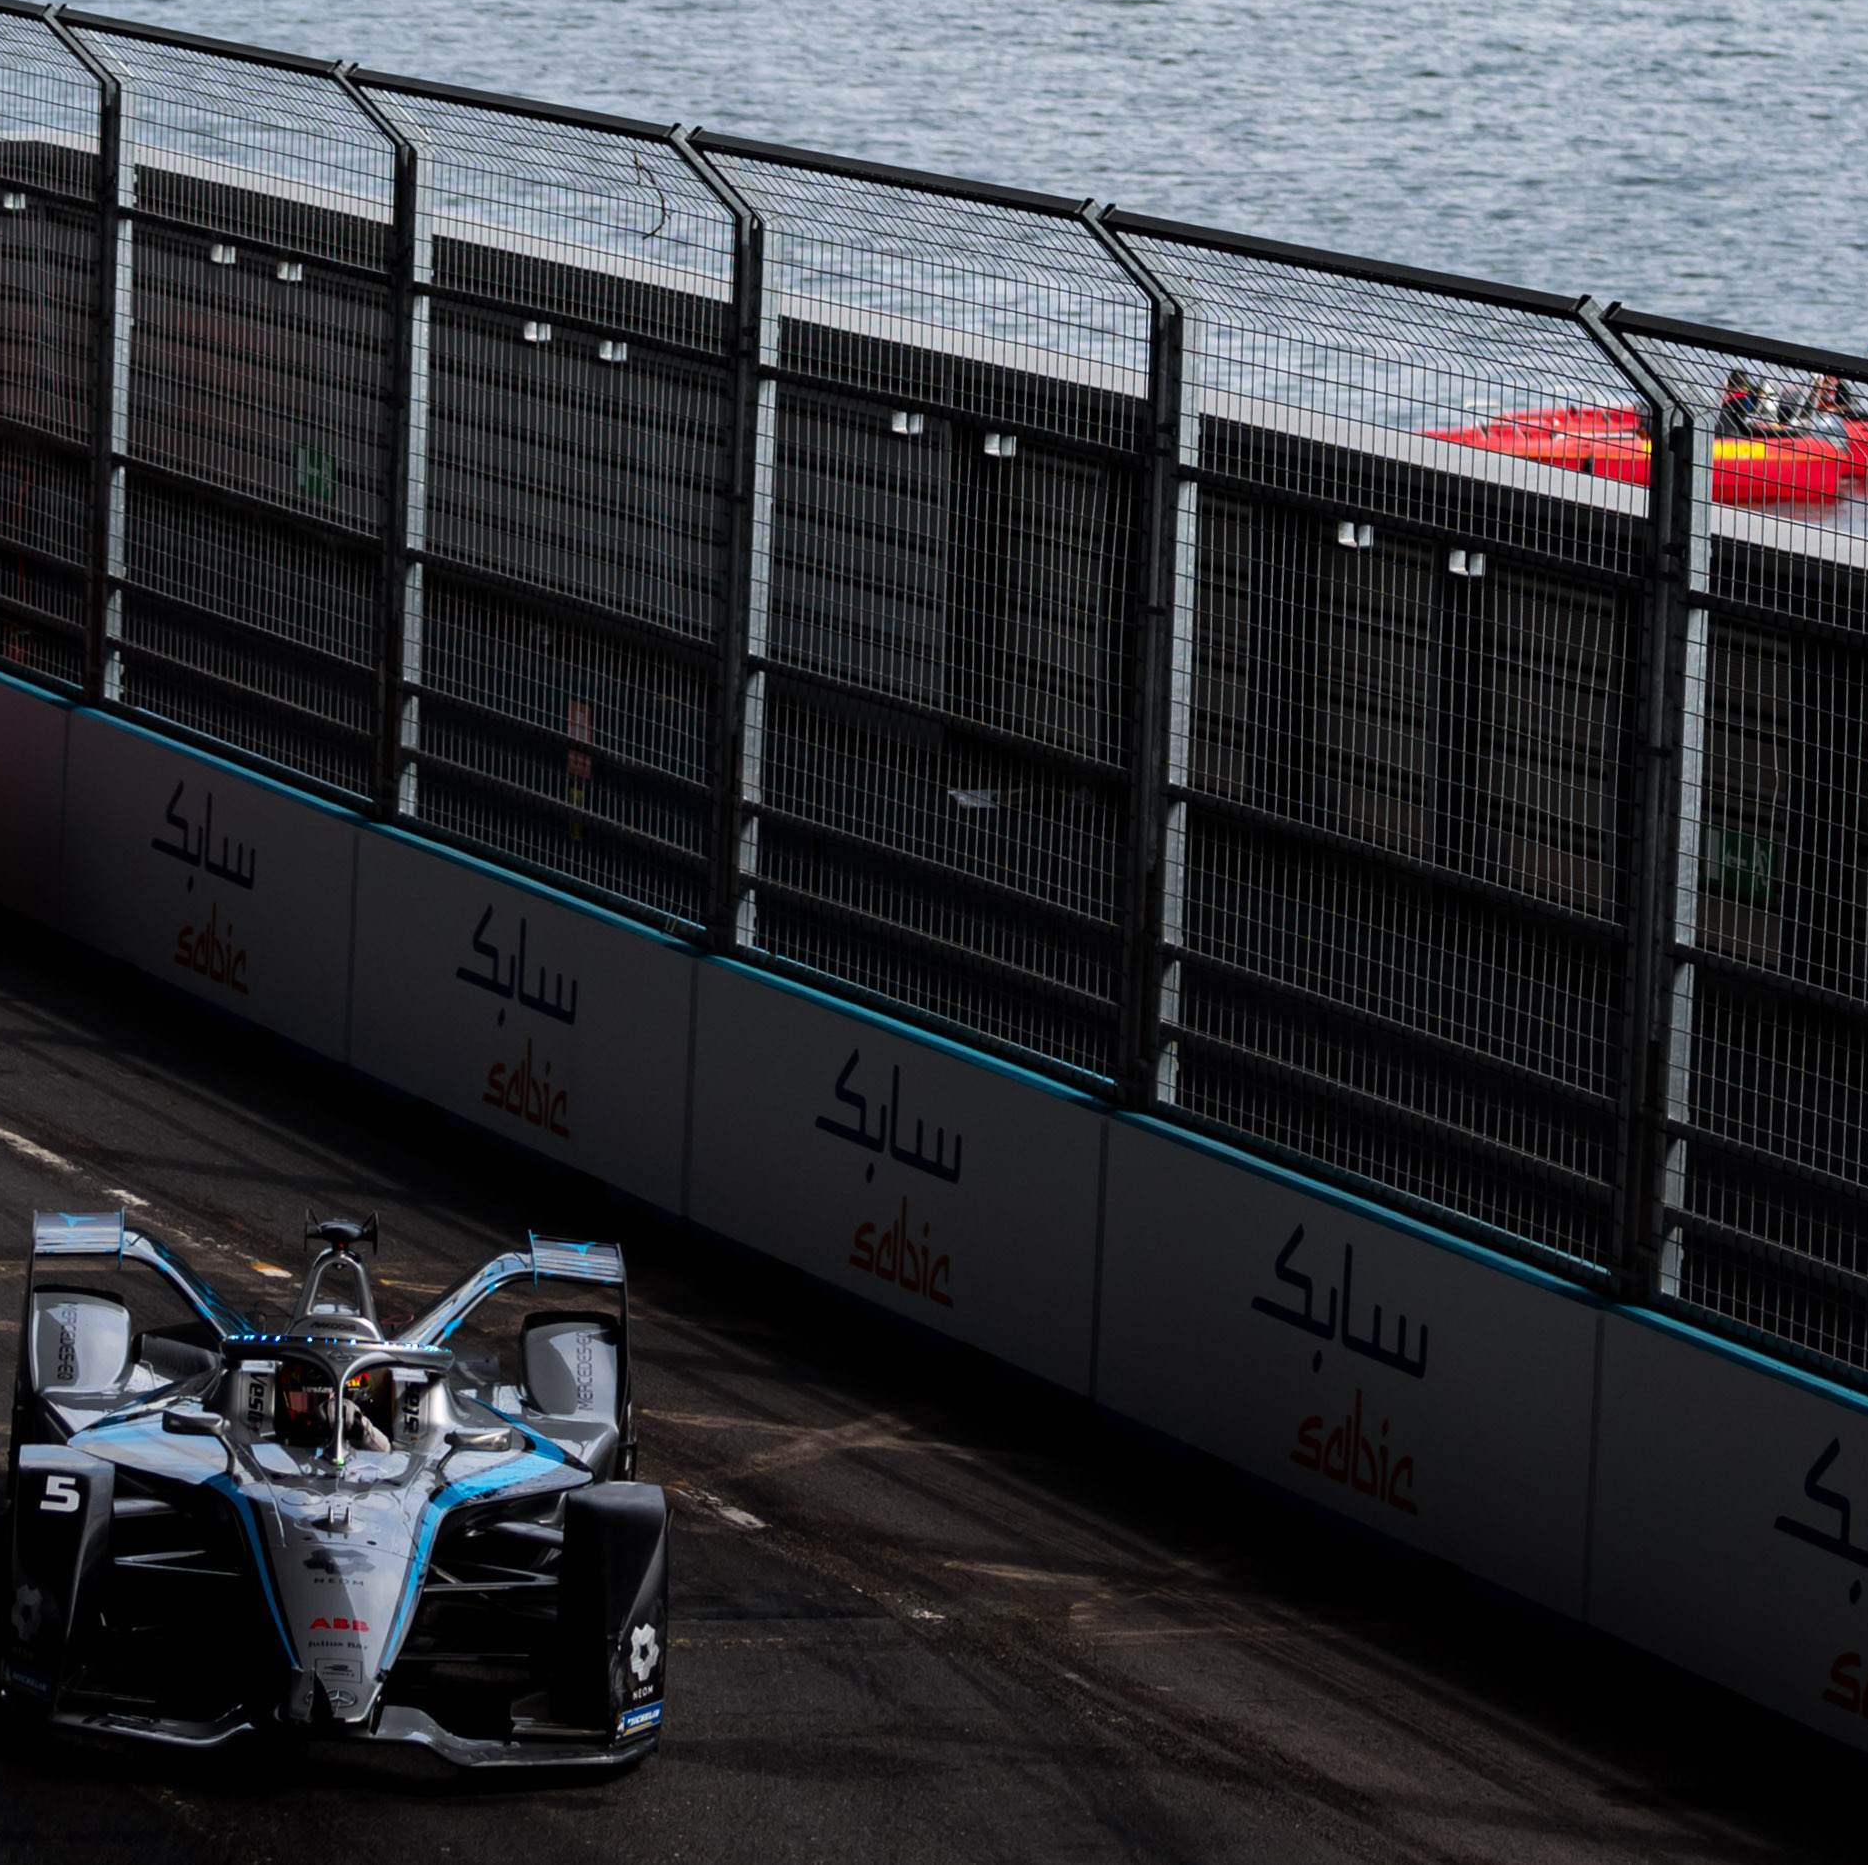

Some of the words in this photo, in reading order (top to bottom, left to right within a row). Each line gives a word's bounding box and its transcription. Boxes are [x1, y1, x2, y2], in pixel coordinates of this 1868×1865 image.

[151, 779, 257, 894] سابك
[173, 902, 250, 996] sabic
[455, 902, 580, 1028] سابك
[483, 1038, 571, 1140] sabic
[814, 1048, 963, 1185] سابك
[847, 1195, 956, 1310] sabic
[1250, 1223, 1430, 1380] سابك
[39, 1474, 81, 1513] 5
[1288, 1388, 1420, 1518] sabic
[309, 1618, 369, 1632] ABB
[313, 1577, 365, 1586] NEOM
[632, 1684, 655, 1702] NEOM
